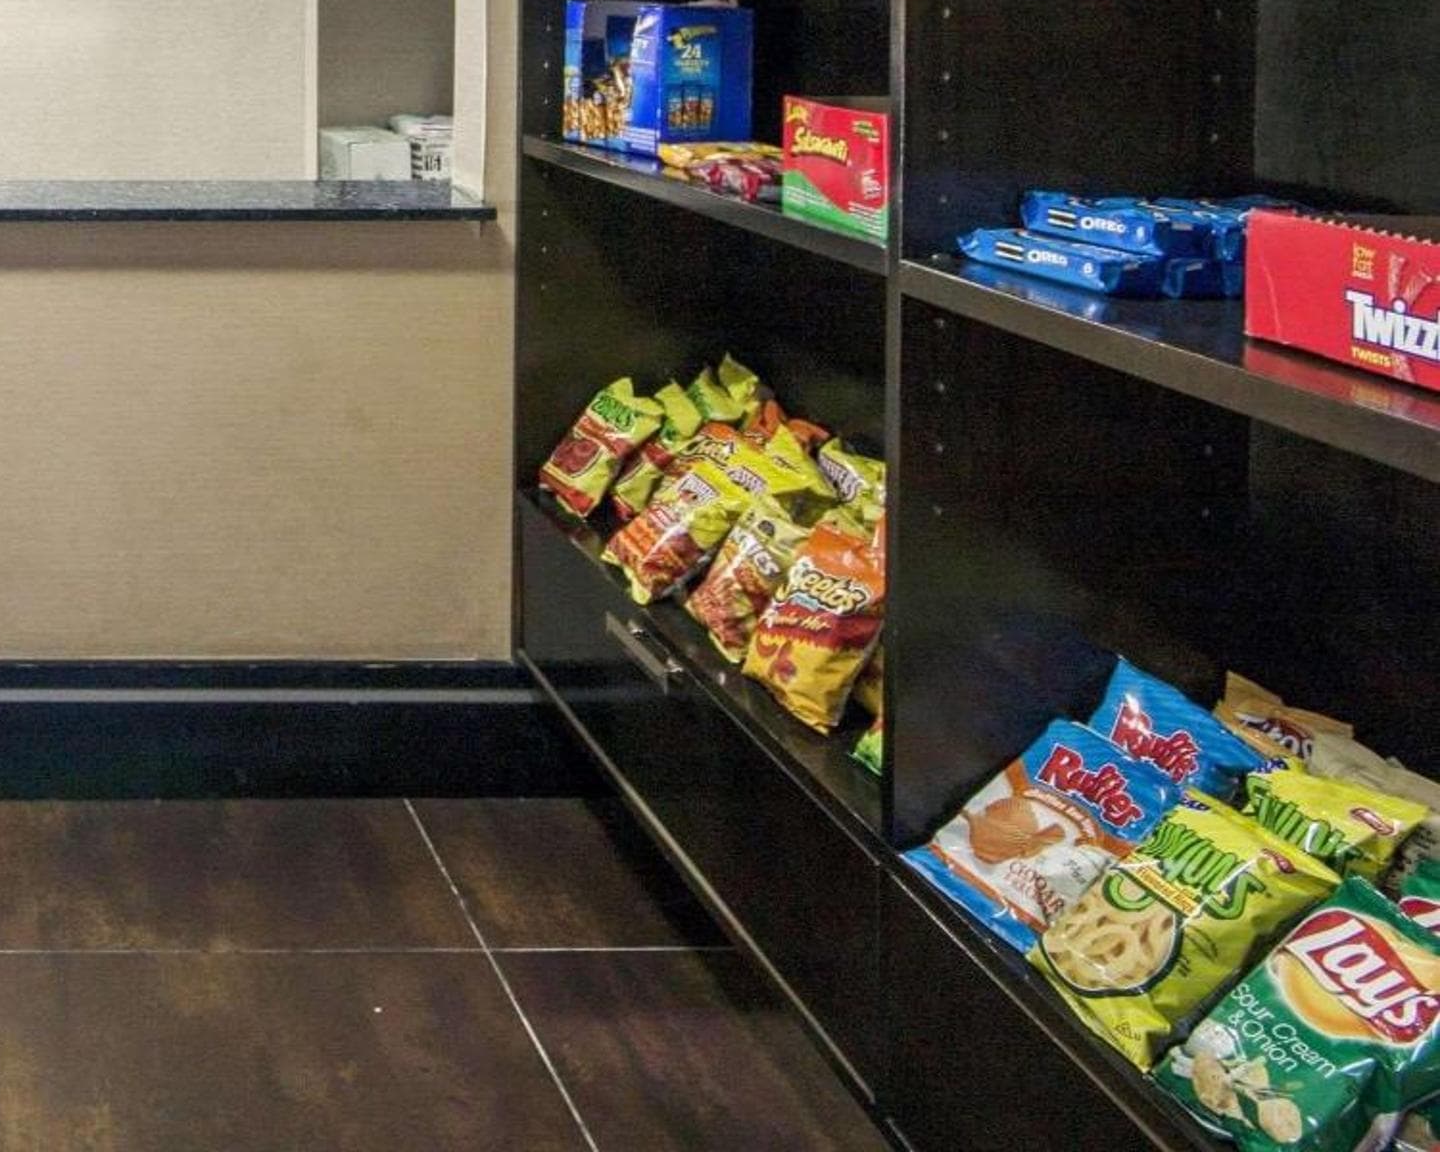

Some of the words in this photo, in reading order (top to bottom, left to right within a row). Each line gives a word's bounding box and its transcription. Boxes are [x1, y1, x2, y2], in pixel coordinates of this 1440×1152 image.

[1080, 216, 1126, 235] OREO
[1027, 248, 1068, 267] OREO
[1035, 744, 1145, 827] Ruffles
[1231, 983, 1275, 1020] Sour
[1272, 1022, 1337, 1078] Cream
[1241, 1019, 1298, 1073] Onion
